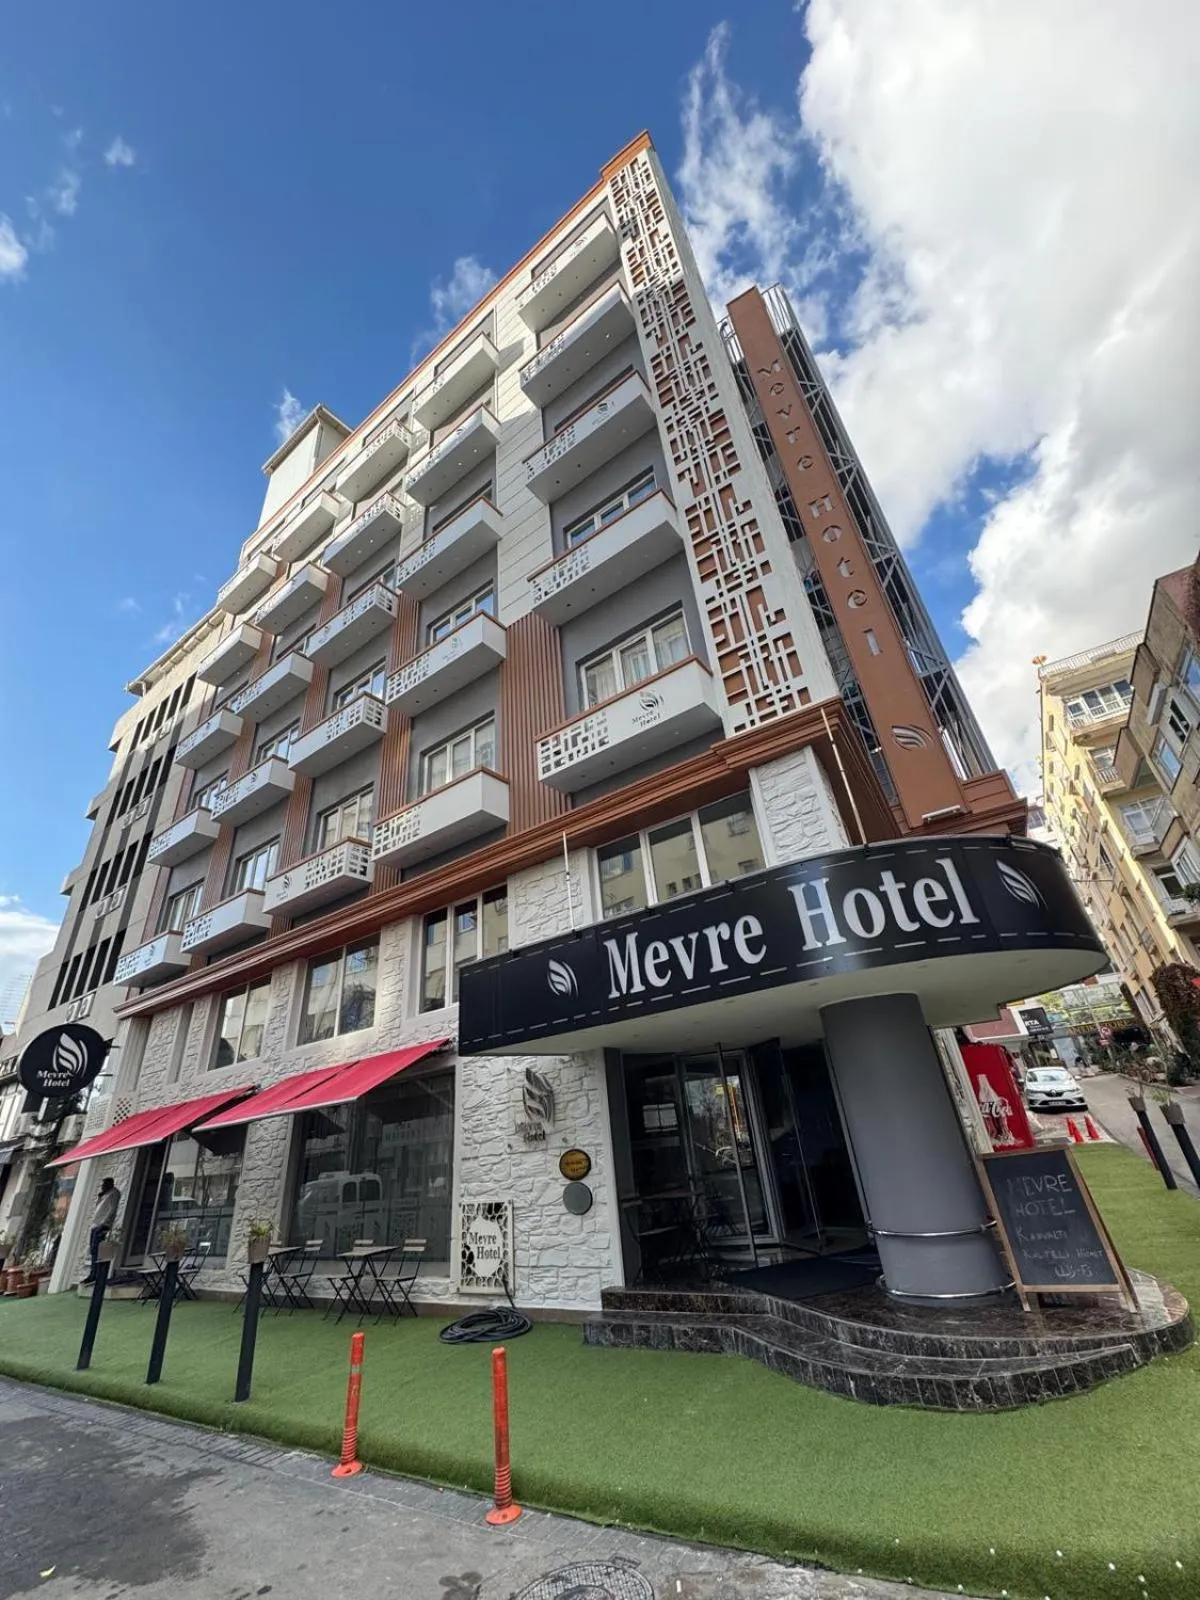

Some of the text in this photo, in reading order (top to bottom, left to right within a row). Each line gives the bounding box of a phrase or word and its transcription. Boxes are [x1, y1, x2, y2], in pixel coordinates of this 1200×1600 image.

[758, 359, 882, 657] Mevre Hotel
[603, 858, 980, 999] Mevre Hotel
[37, 1070, 71, 1079] Mevre
[43, 1078, 70, 1087] Hotel
[1015, 1197, 1077, 1217] HOTEL
[469, 1231, 497, 1245] Mevre
[477, 1246, 501, 1259] Hotel
